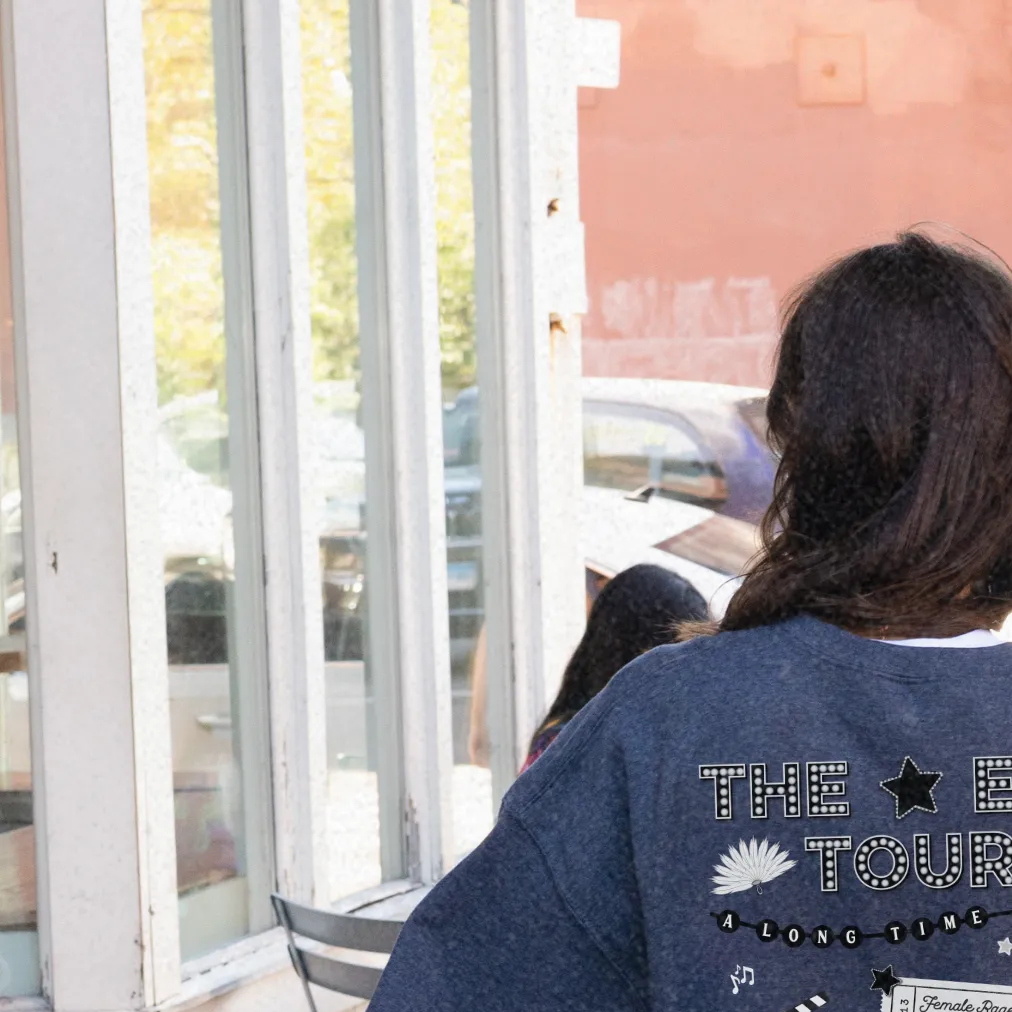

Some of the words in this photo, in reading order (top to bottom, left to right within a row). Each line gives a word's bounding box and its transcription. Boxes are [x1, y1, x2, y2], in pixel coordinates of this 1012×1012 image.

[699, 760, 850, 819] THE
[761, 922, 857, 944] LONG
[890, 910, 982, 940] TIME
[919, 994, 975, 1012] Female
